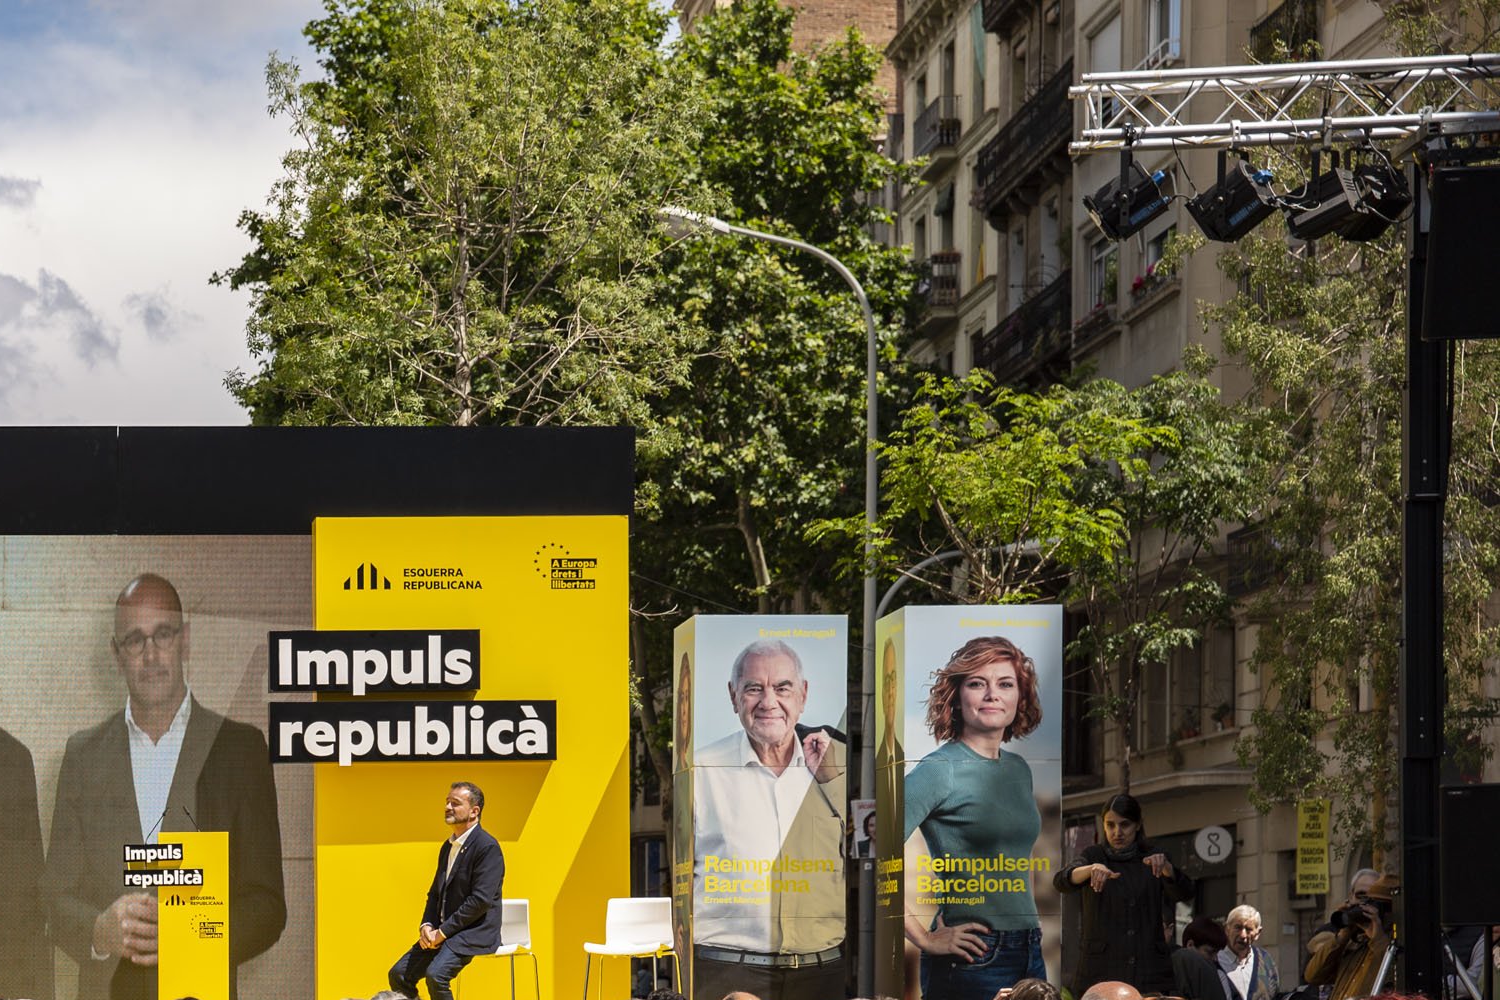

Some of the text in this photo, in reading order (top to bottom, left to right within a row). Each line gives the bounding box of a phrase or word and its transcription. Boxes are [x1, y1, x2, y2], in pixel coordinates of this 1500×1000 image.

[403, 568, 463, 577] ESQUERRA
[552, 560, 597, 569] A Europa,
[552, 570, 577, 578] drets
[403, 580, 483, 590] REPUBLICANA
[552, 580, 594, 589] llibertats
[278, 635, 473, 695] Impuls
[279, 705, 548, 766] republicà
[125, 844, 182, 863] Impuls
[704, 855, 834, 875] Reimpulsem
[916, 853, 1050, 875] Reimpulsem
[125, 870, 202, 888] republicà
[704, 875, 810, 893] Barcelona
[916, 875, 1026, 893] Barcelona
[704, 896, 732, 904] Ernest
[947, 896, 985, 906] Maragall
